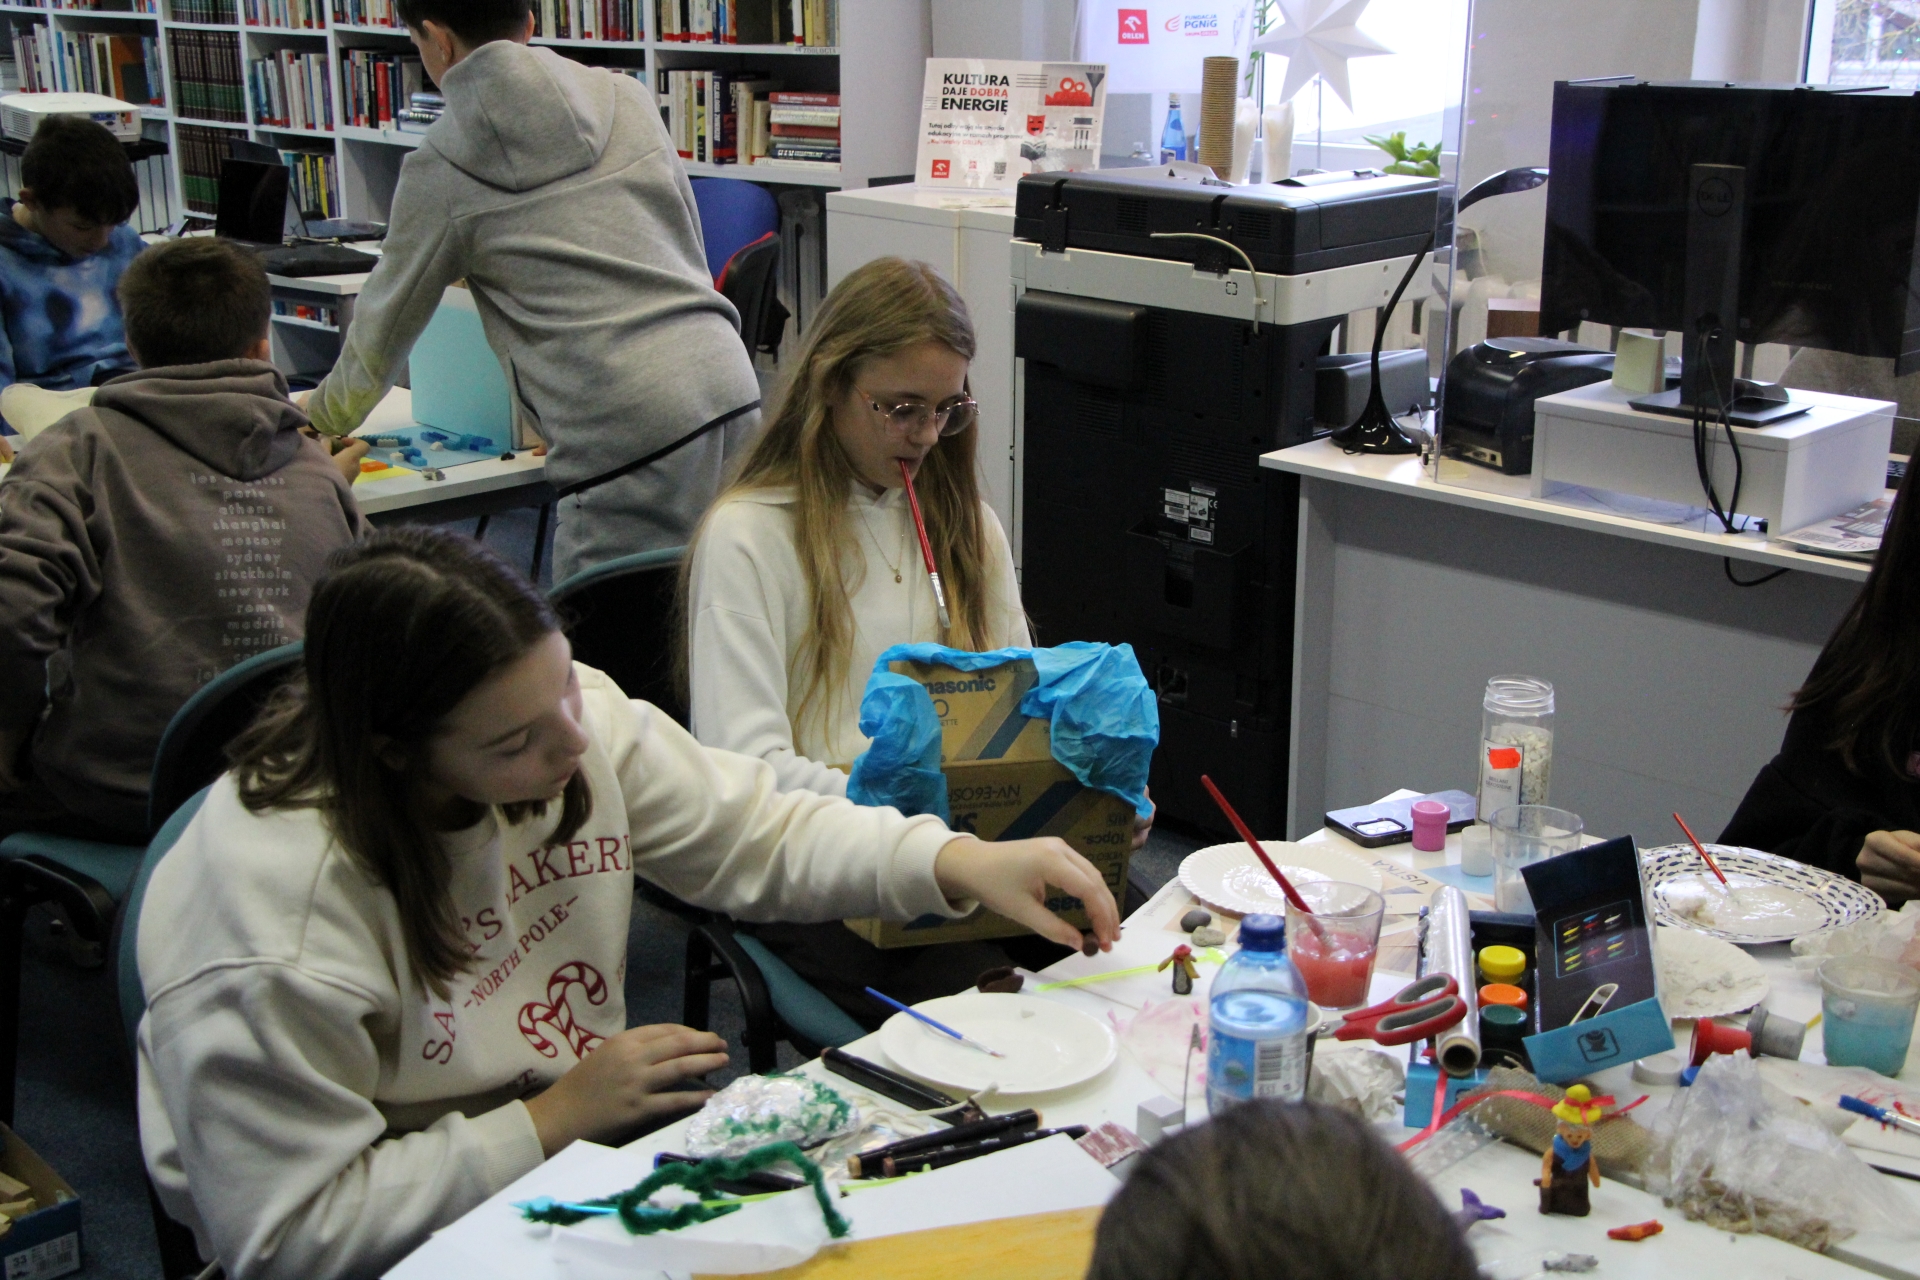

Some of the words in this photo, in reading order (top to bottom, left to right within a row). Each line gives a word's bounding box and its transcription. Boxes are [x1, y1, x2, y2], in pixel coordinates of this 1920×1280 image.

[1184, 20, 1217, 29] PGNiG
[943, 73, 1010, 87] KULTURA
[942, 87, 968, 96] DAJE
[970, 88, 1009, 98] DOBRĄ
[941, 98, 1009, 115] ENERGIĘ
[928, 122, 943, 130] Tutaj
[190, 472, 217, 484] los
[223, 488, 266, 502] paris
[219, 502, 274, 515] athens
[213, 517, 287, 532] shanghai
[222, 537, 282, 547] moscow
[226, 549, 281, 566] sydney
[215, 566, 292, 581] stockholm
[218, 588, 251, 598] new
[256, 584, 290, 599] york
[236, 603, 275, 614] rome
[226, 616, 285, 630] madrid
[924, 674, 996, 695] nasonic
[940, 719, 958, 727] ETTE
[1083, 831, 1125, 845] 10pcs.
[506, 834, 631, 911] AKER
[1372, 860, 1429, 886] USTKA
[13, 1254, 27, 1267] 33
